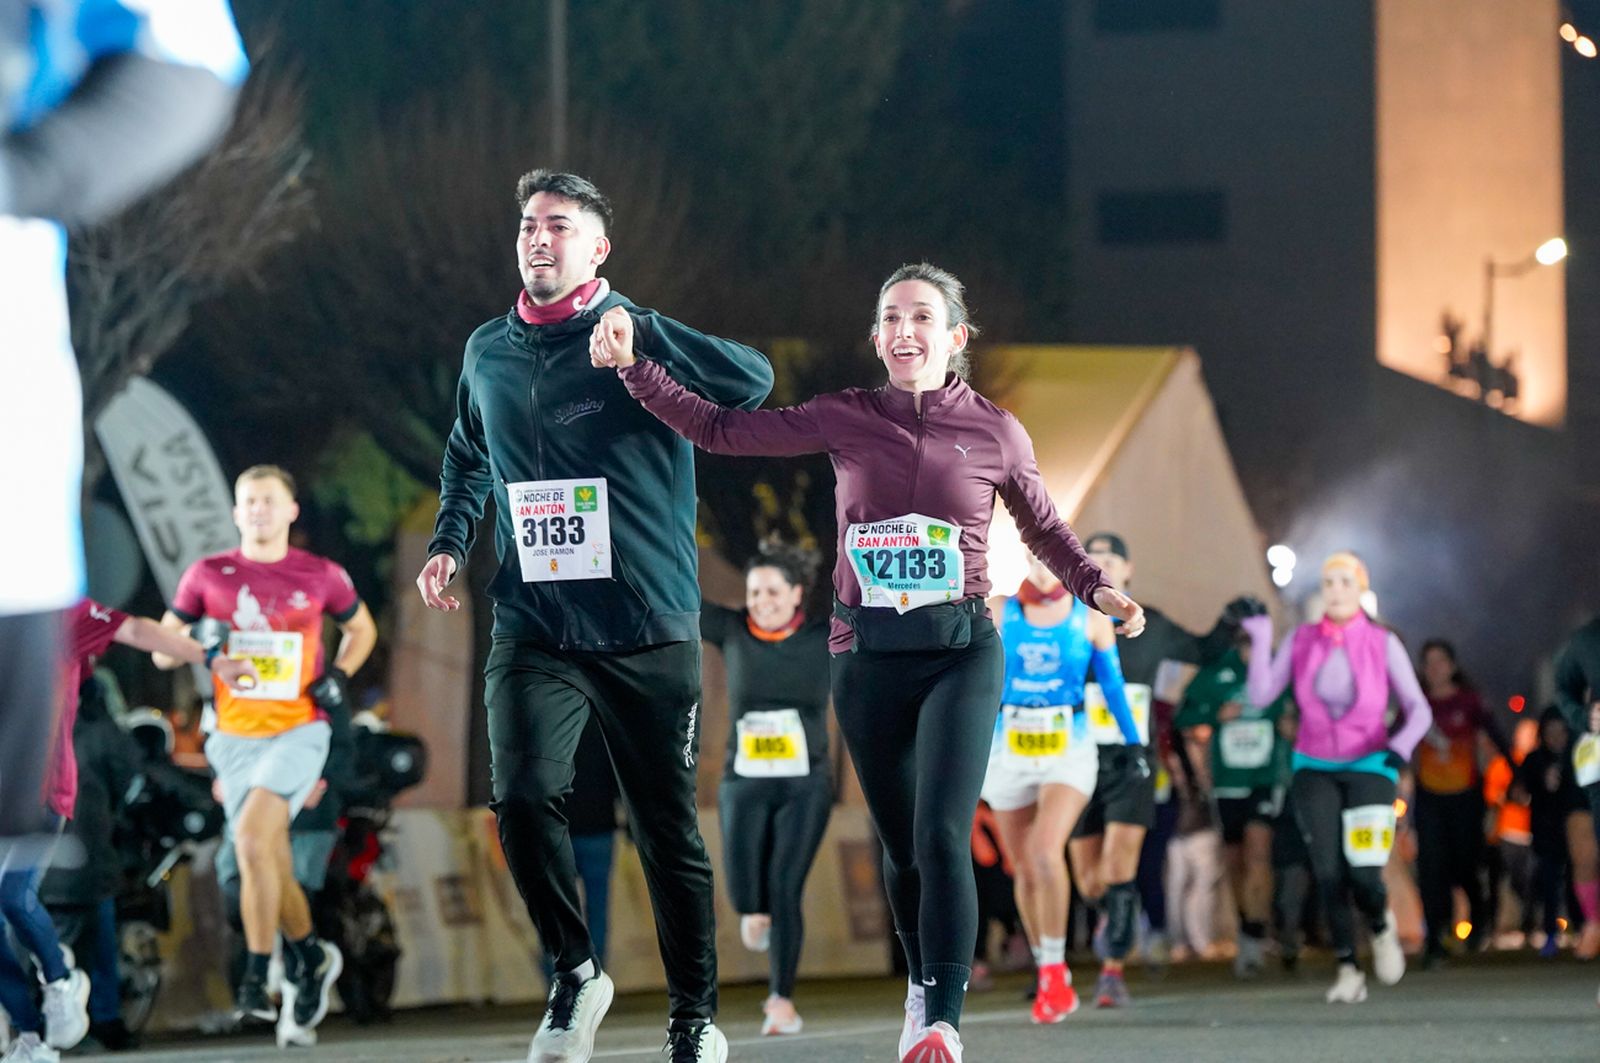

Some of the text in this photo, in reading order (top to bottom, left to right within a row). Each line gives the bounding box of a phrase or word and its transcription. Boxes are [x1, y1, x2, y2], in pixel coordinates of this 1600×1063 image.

[523, 491, 551, 503] NOCHE
[552, 490, 565, 502] DE
[533, 501, 566, 515] ANTÓN
[522, 515, 585, 548] 3133
[870, 524, 917, 534] NOCHE DE
[857, 535, 880, 548] SAN
[882, 533, 919, 547] ANTÓN
[532, 547, 575, 557] JOSE RAMON
[861, 548, 946, 580] 12133
[887, 581, 921, 590] Mercedes
